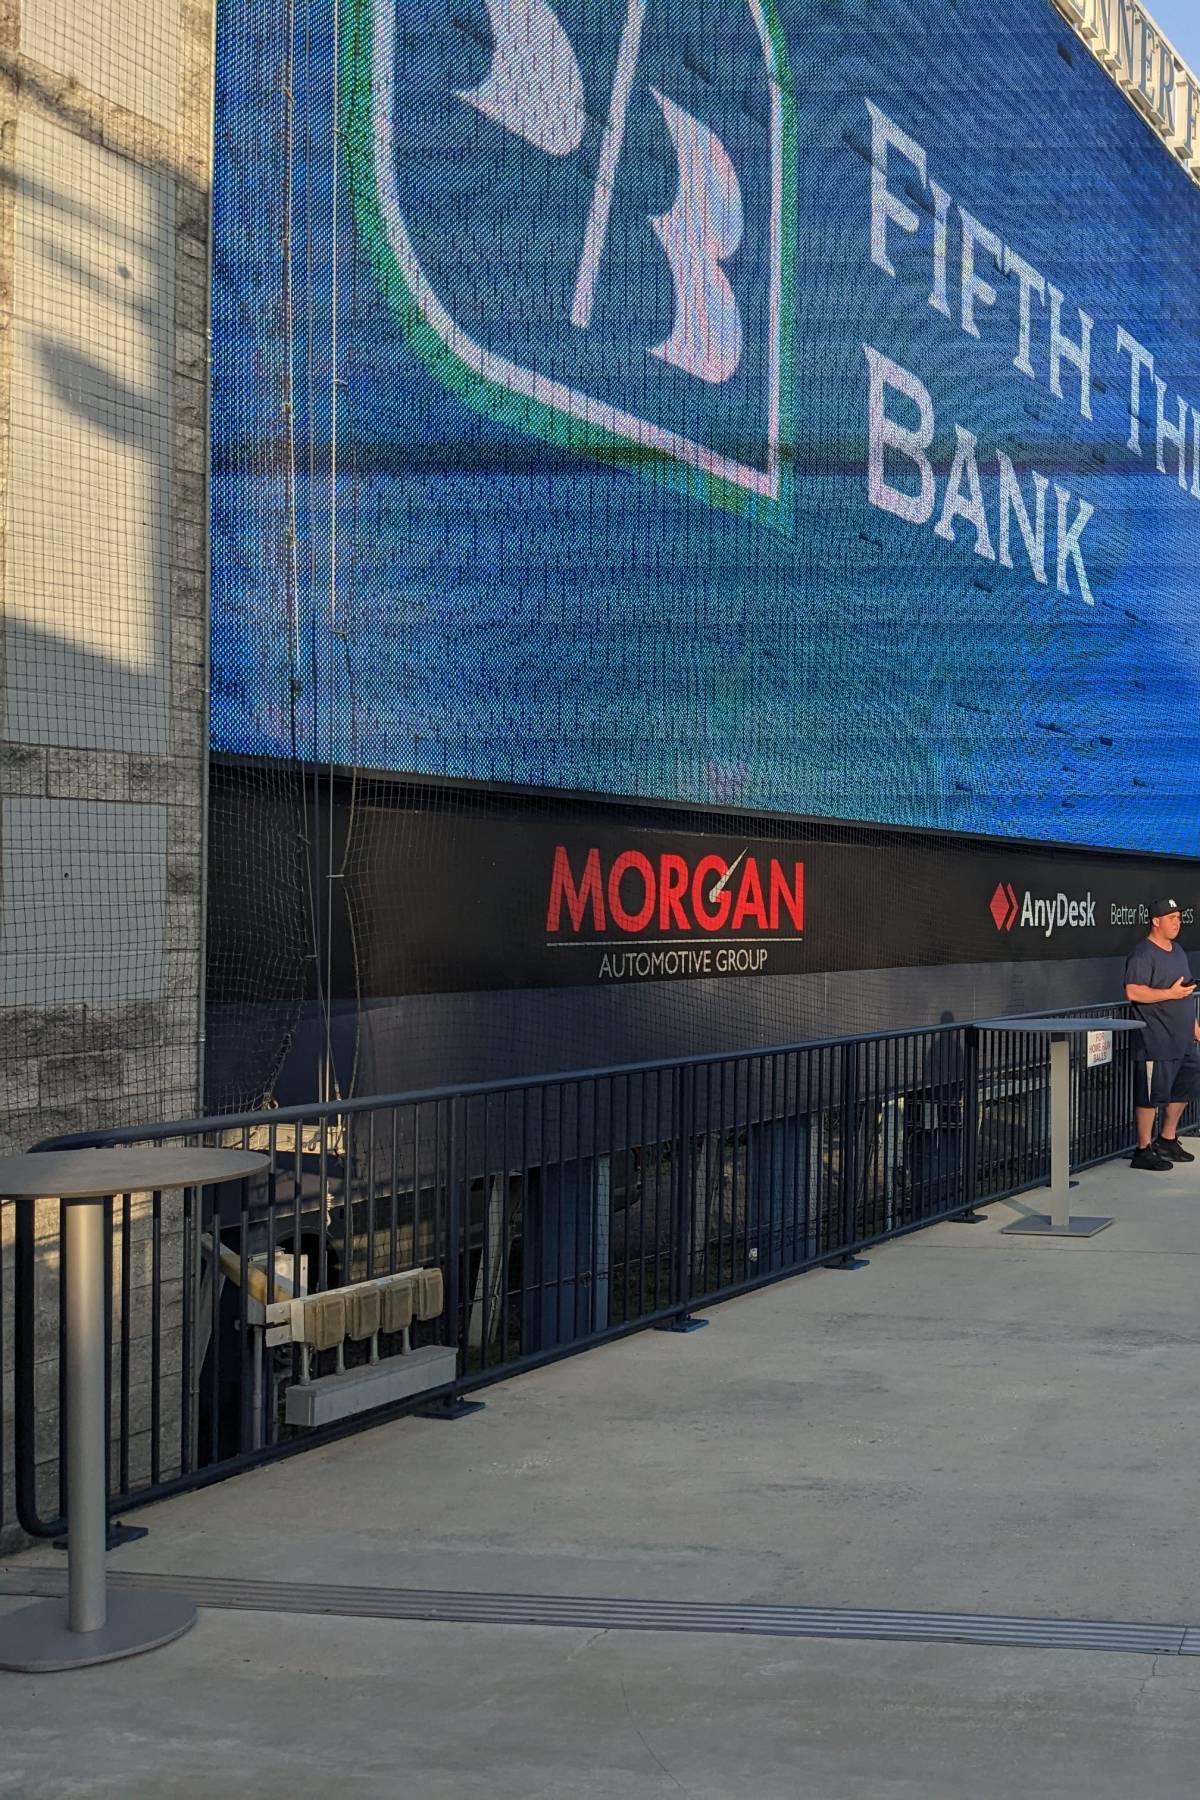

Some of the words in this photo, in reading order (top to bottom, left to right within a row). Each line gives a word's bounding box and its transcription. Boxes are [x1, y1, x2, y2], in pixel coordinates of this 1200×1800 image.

[864, 97, 1094, 421] FIFTH
[862, 343, 1095, 605] BANK
[546, 845, 805, 932] MORGAN
[1020, 891, 1096, 937] AnyDesk
[1110, 903, 1137, 925] Better
[598, 950, 711, 978] AUTOMOTIVE
[716, 949, 767, 971] GROUP
